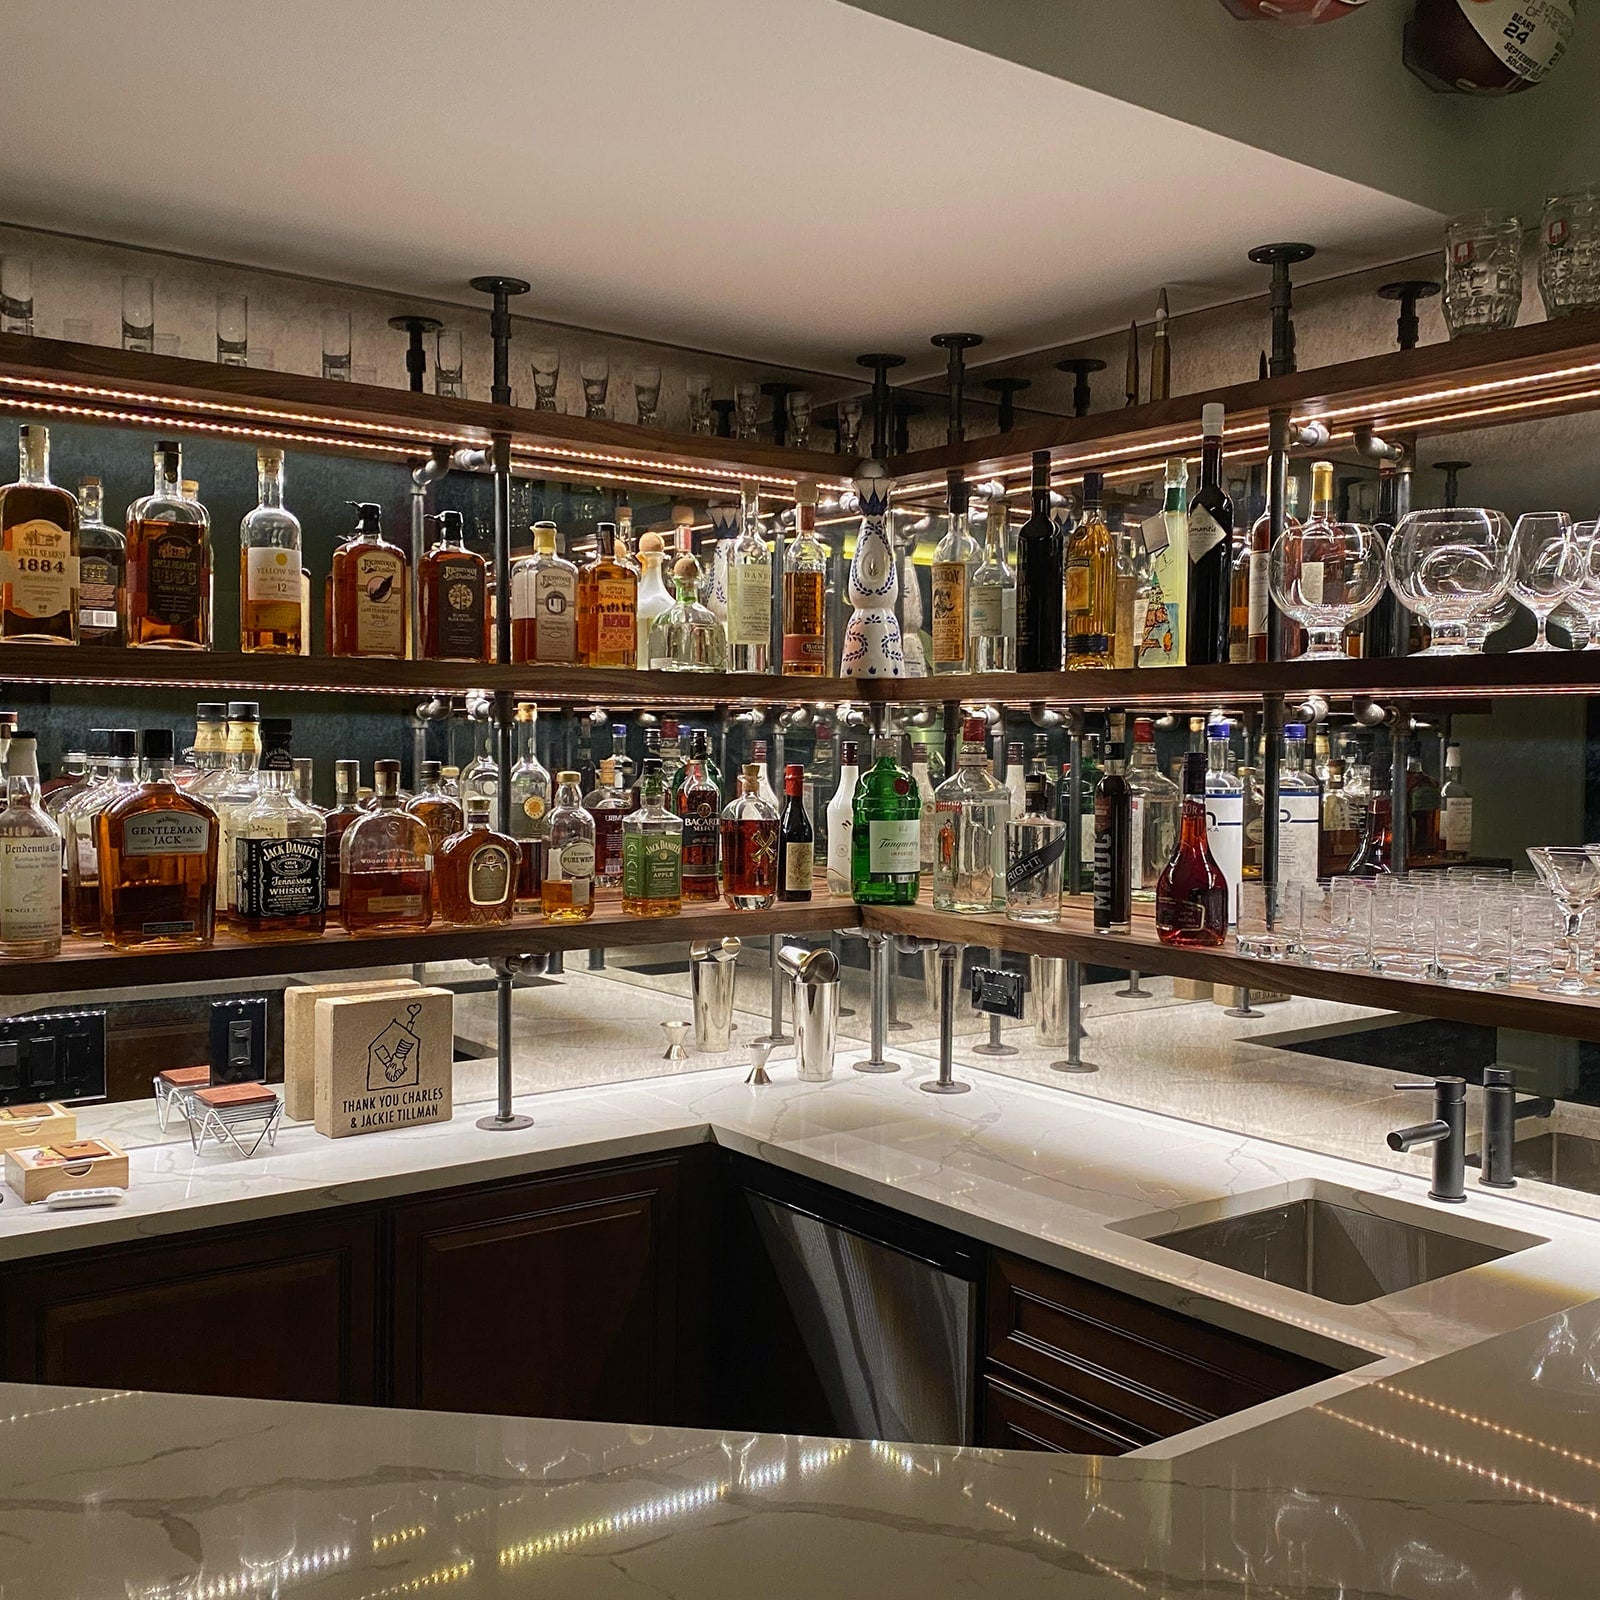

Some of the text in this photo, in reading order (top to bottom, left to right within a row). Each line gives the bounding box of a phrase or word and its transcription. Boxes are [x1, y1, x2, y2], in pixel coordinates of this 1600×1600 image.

[1512, 12, 1536, 33] BEARS
[1503, 22, 1530, 44] 24
[1506, 55, 1531, 75] SOLDIER
[18, 557, 65, 573] 1884
[257, 567, 287, 575] YELLOW
[276, 582, 288, 593] 12
[131, 826, 202, 836] GENTLEMAN
[153, 836, 182, 846] JACK
[5, 843, 50, 854] Pendennis
[263, 841, 320, 862] JACK DANIEL'S
[646, 843, 661, 856] JACK
[563, 856, 580, 864] PURE
[1006, 855, 1040, 883] RIGHT
[269, 886, 313, 896] WHISKEY
[343, 1087, 444, 1114] THANK YOU CHARLES
[350, 1104, 438, 1129] & JACKIE TILLMAN
